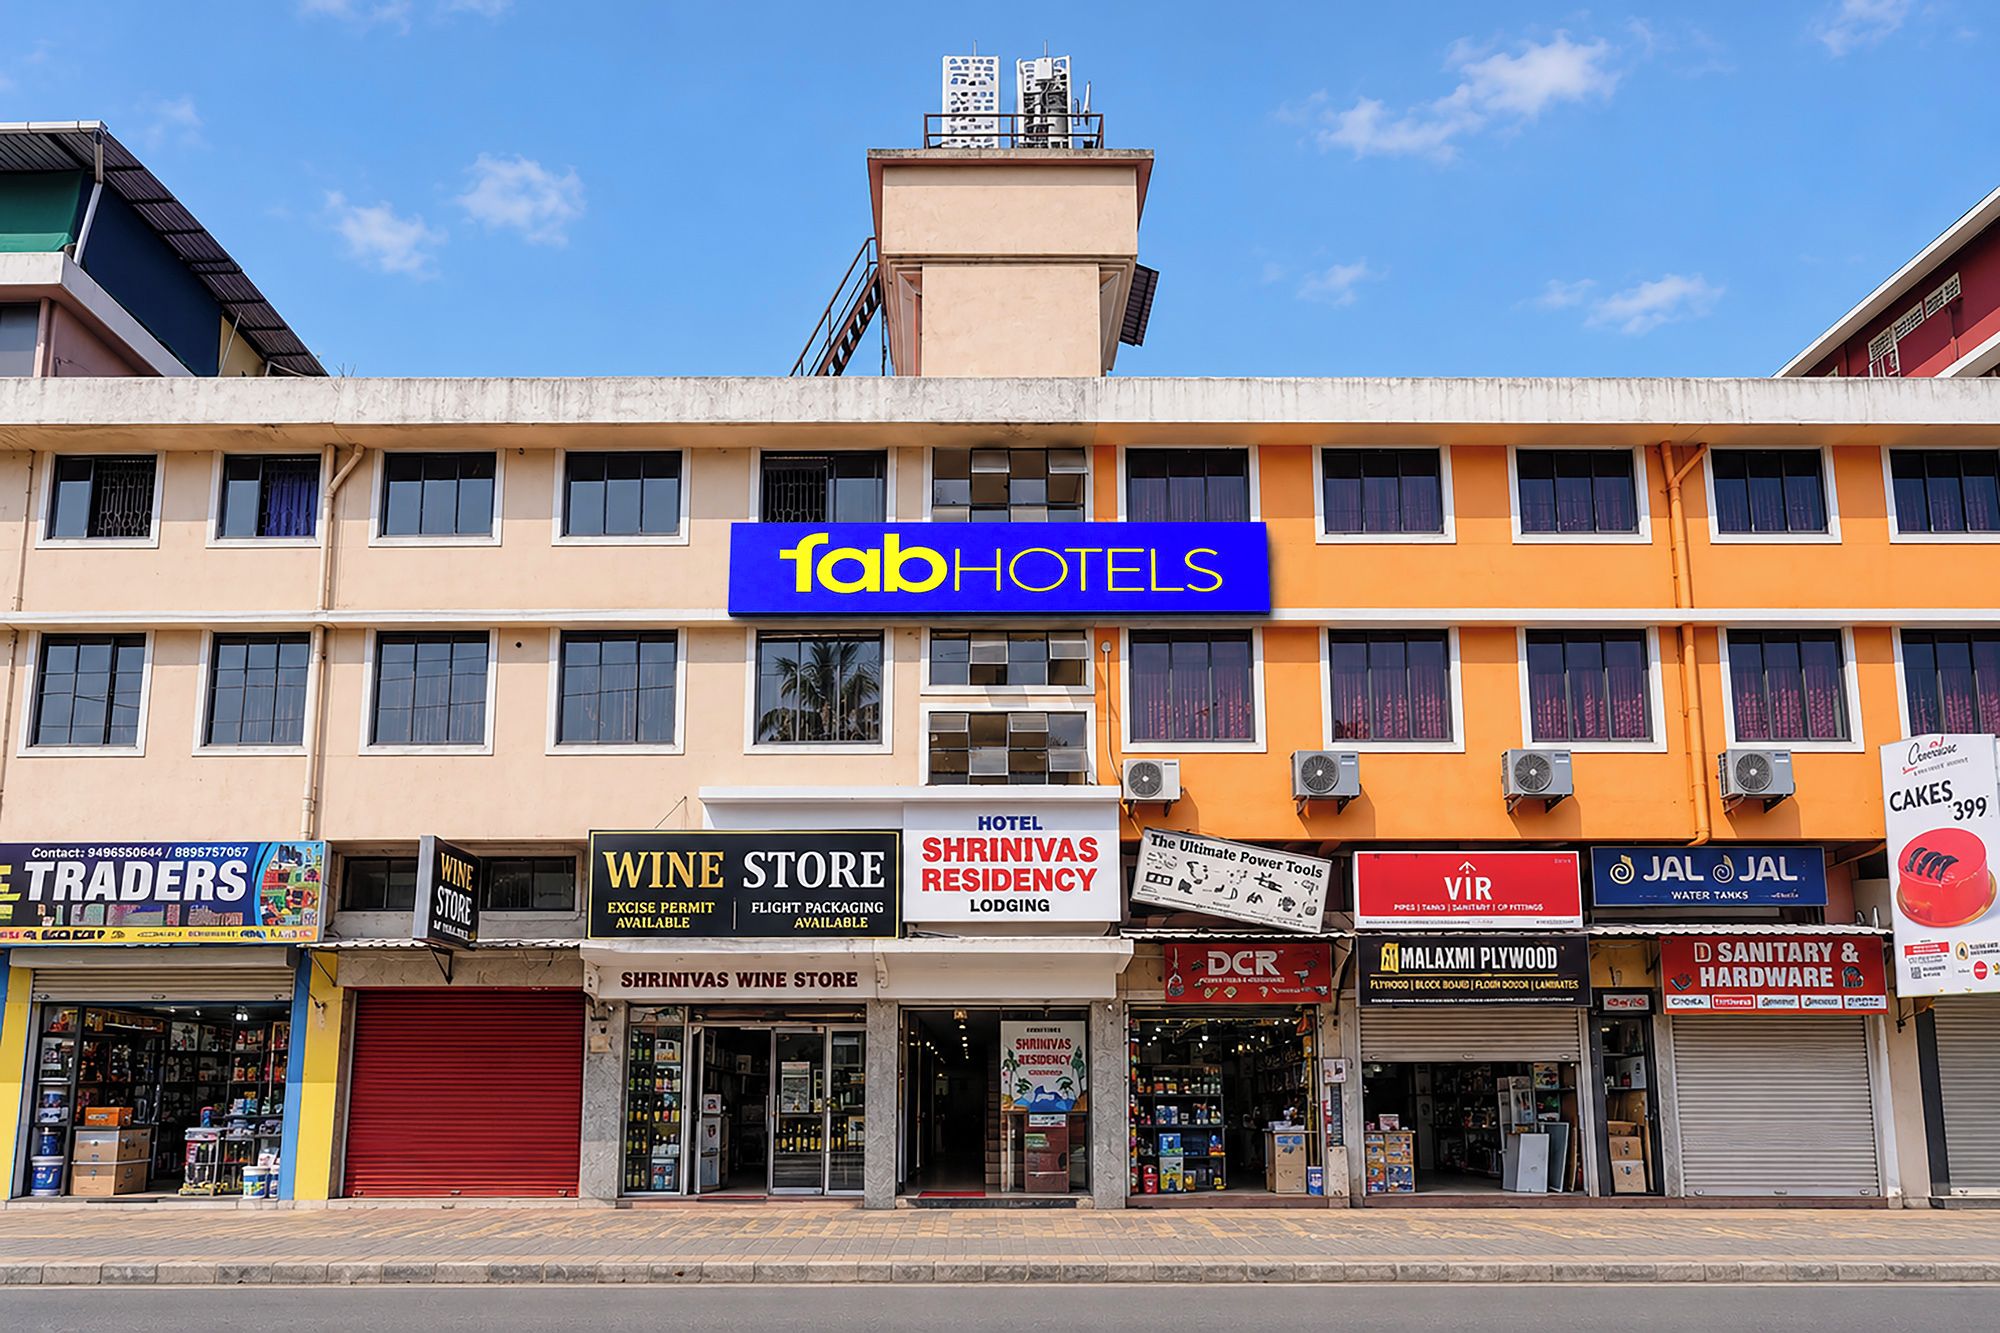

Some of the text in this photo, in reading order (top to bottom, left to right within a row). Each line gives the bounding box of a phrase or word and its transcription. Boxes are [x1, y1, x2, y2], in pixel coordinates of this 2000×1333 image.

[1889, 780, 1953, 812] CAKES
[978, 816, 1043, 831] HOTEL
[31, 847, 86, 858] Contact:
[922, 836, 1099, 863] SHRINIVAS
[1151, 833, 1323, 878] The Ultimate Power Tools
[441, 852, 474, 891] WINE
[602, 851, 886, 888] WINE STORE
[922, 867, 1098, 892] RESIDENCY
[1643, 856, 1798, 881] JAL JAL
[24, 860, 248, 901] TRADERS
[436, 885, 472, 925] STORE
[970, 898, 1050, 912] LODGING
[1671, 891, 1710, 900] WATER
[607, 901, 715, 914] EXCISE PERMIT
[751, 902, 884, 914] FLIGHT PACKAGING
[615, 916, 690, 929] AVAILABLE
[794, 916, 868, 928] AVAILABLE
[1208, 950, 1280, 976] DCR
[1401, 947, 1558, 970] MALAXMI PLYWOOD
[1718, 942, 1833, 963] SANITARY
[1841, 942, 1859, 962] &
[621, 972, 858, 988] SHRINIVAS WINE STORE
[1700, 967, 1833, 988] HARDWARE
